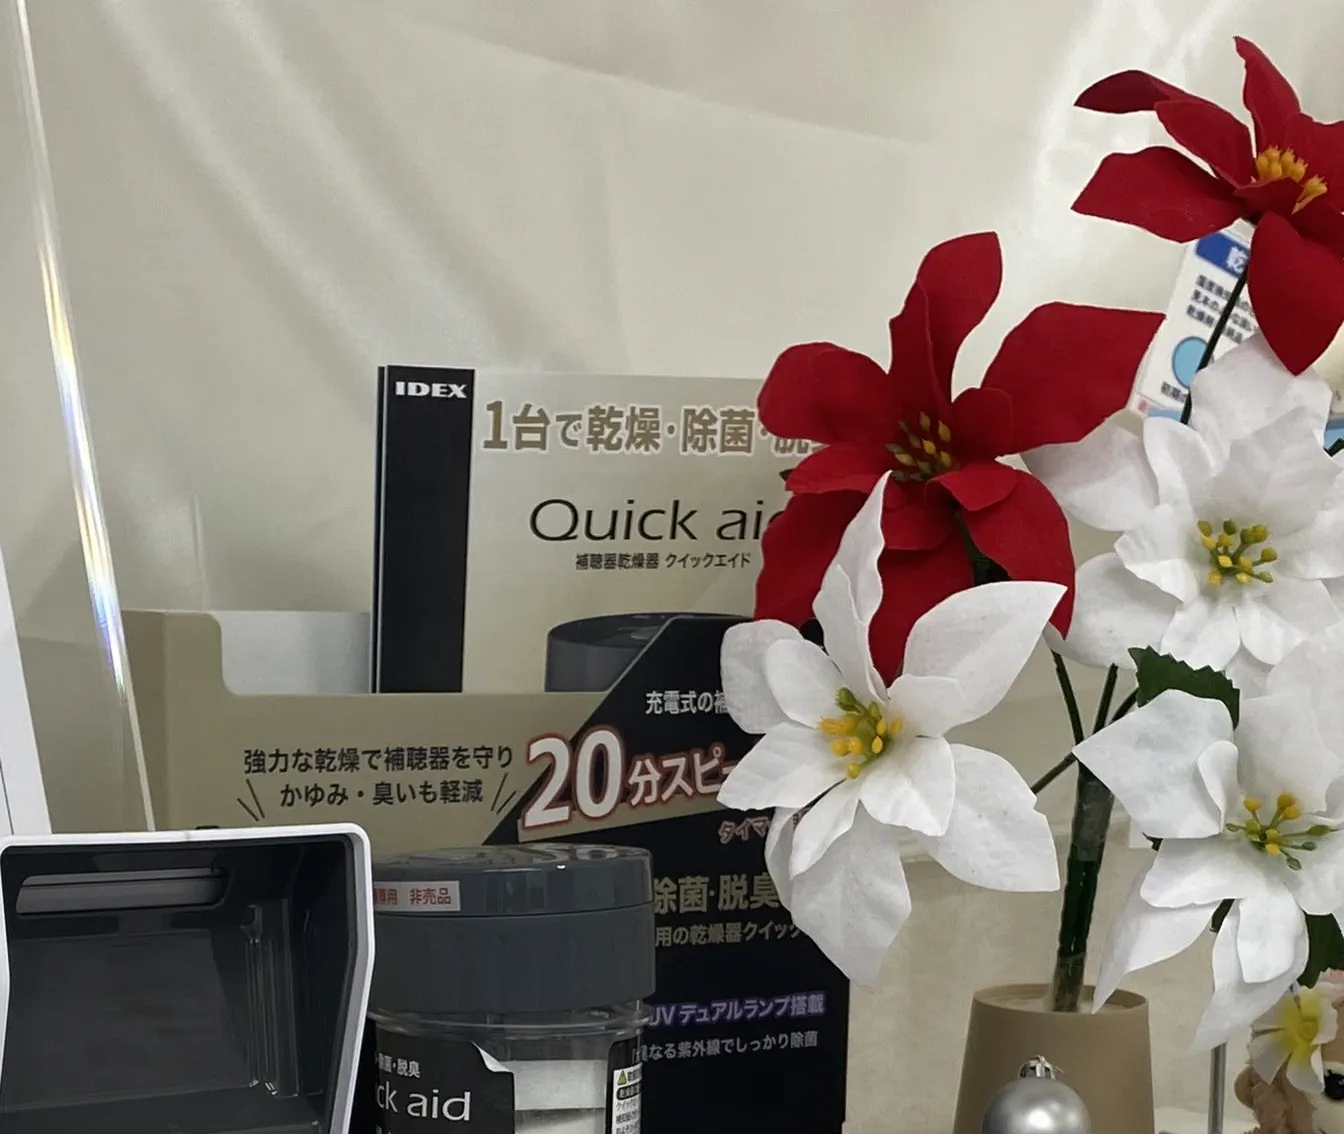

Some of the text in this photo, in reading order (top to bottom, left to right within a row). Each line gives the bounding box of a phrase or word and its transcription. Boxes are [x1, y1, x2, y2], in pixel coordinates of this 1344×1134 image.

[394, 379, 468, 399] IDEX
[529, 499, 785, 542] Quick ai
[665, 551, 752, 569] クイックエイド
[243, 744, 514, 775] 強力な乾燥で補聴器を守り
[280, 779, 484, 808] かゆみ・臭いも軽減
[717, 815, 771, 845] タイマ
[409, 887, 452, 905] 非売品
[407, 1088, 471, 1121] aid
